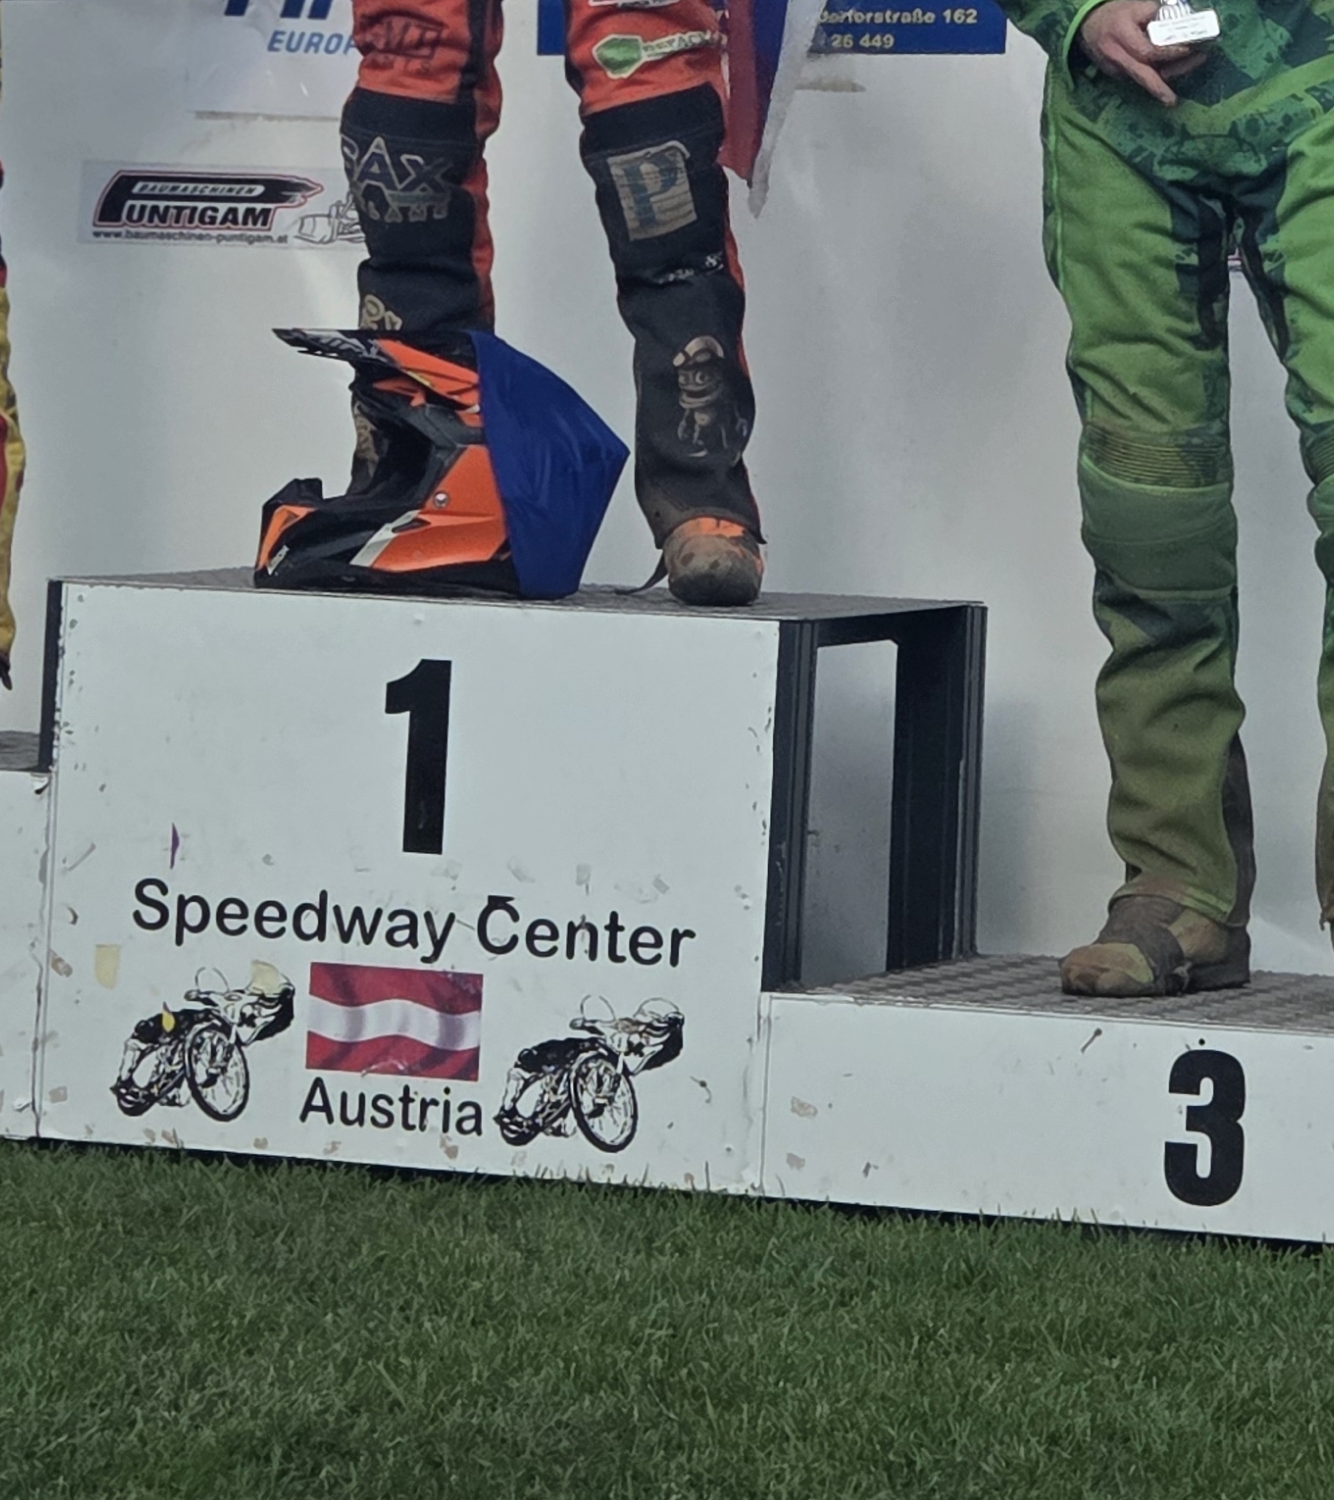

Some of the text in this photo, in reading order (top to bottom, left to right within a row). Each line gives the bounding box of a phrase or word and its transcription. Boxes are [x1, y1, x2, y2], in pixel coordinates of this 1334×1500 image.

[859, 34, 894, 48] 449
[943, 9, 977, 24] 162
[385, 658, 452, 855] 1
[132, 878, 697, 968] Speedway Center
[299, 1077, 484, 1137] Austria
[1164, 1048, 1247, 1207] 3
